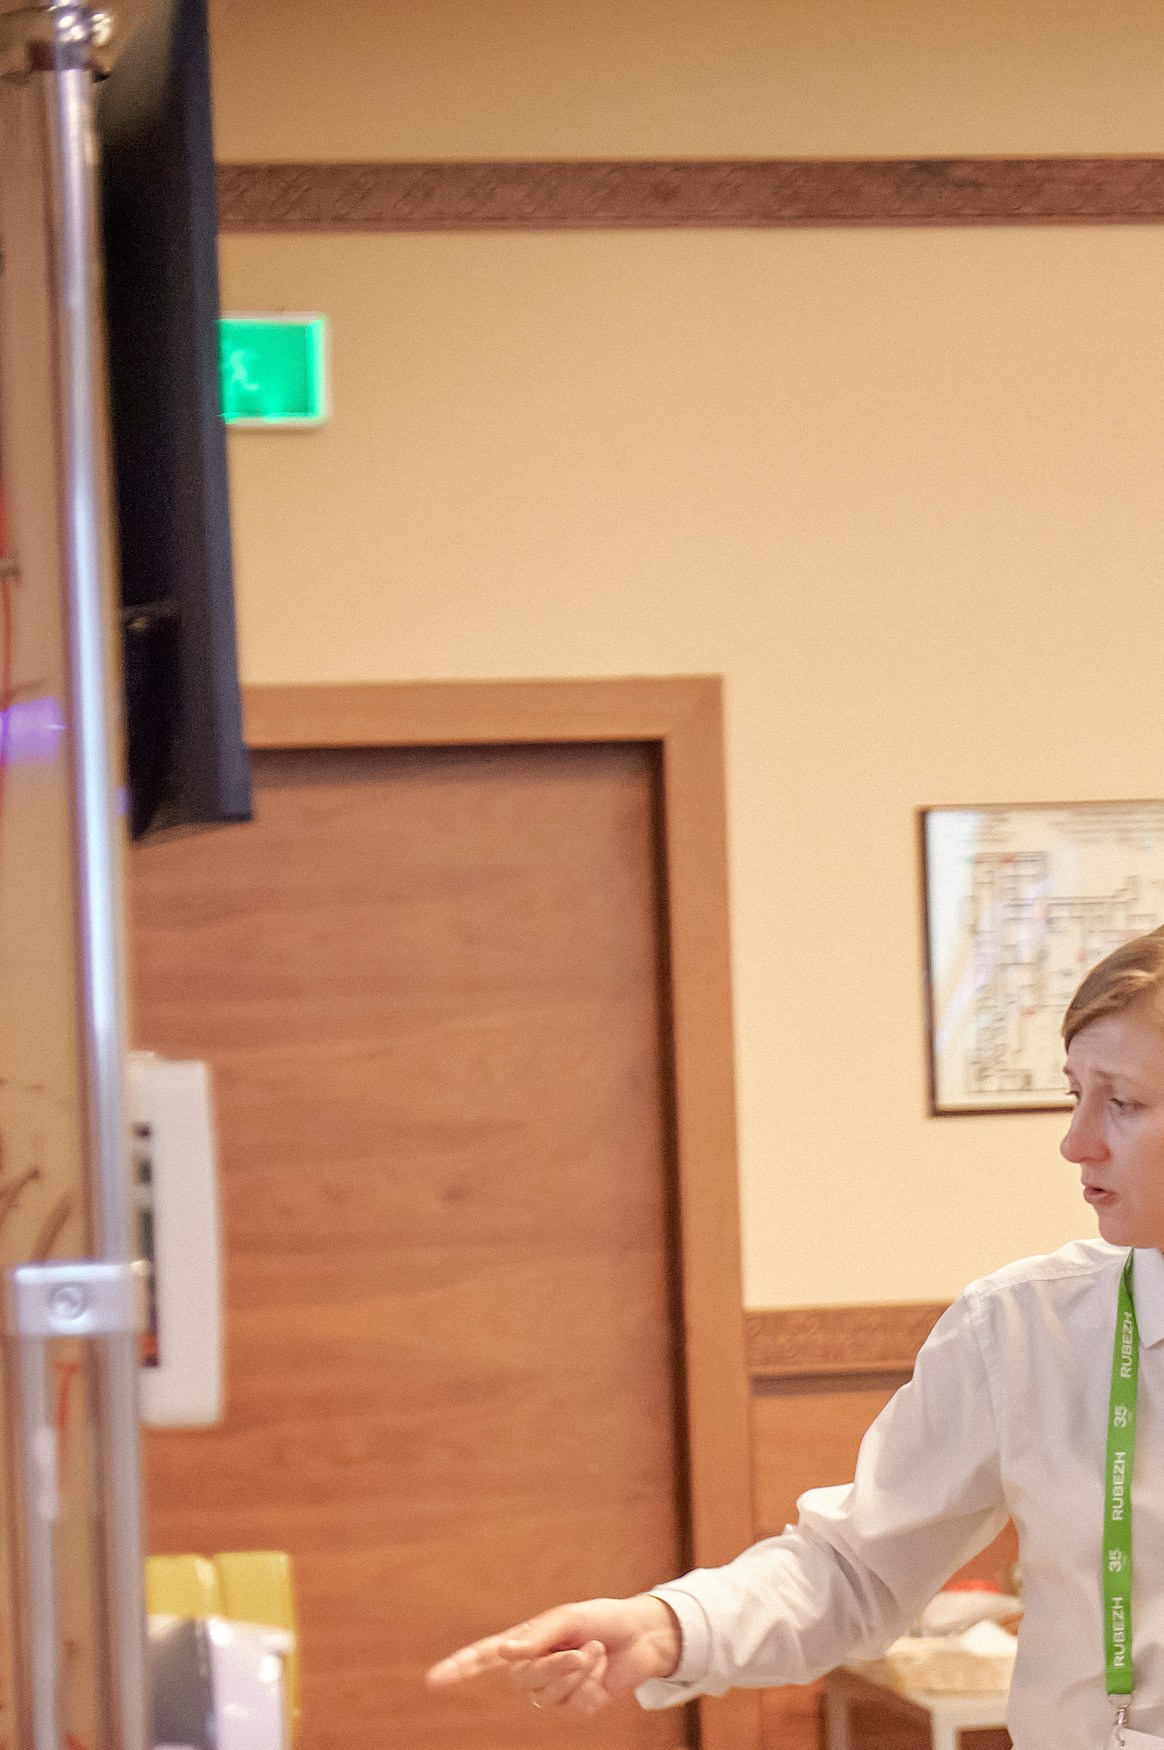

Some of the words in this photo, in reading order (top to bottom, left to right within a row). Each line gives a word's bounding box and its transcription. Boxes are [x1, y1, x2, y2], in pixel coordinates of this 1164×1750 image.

[1120, 1311, 1134, 1378] RUBEZH
[1113, 1404, 1128, 1428] 35
[1112, 1451, 1126, 1520] RUBEZH
[1109, 1549, 1122, 1572] 35
[1112, 1596, 1126, 1667] RUBEZH
